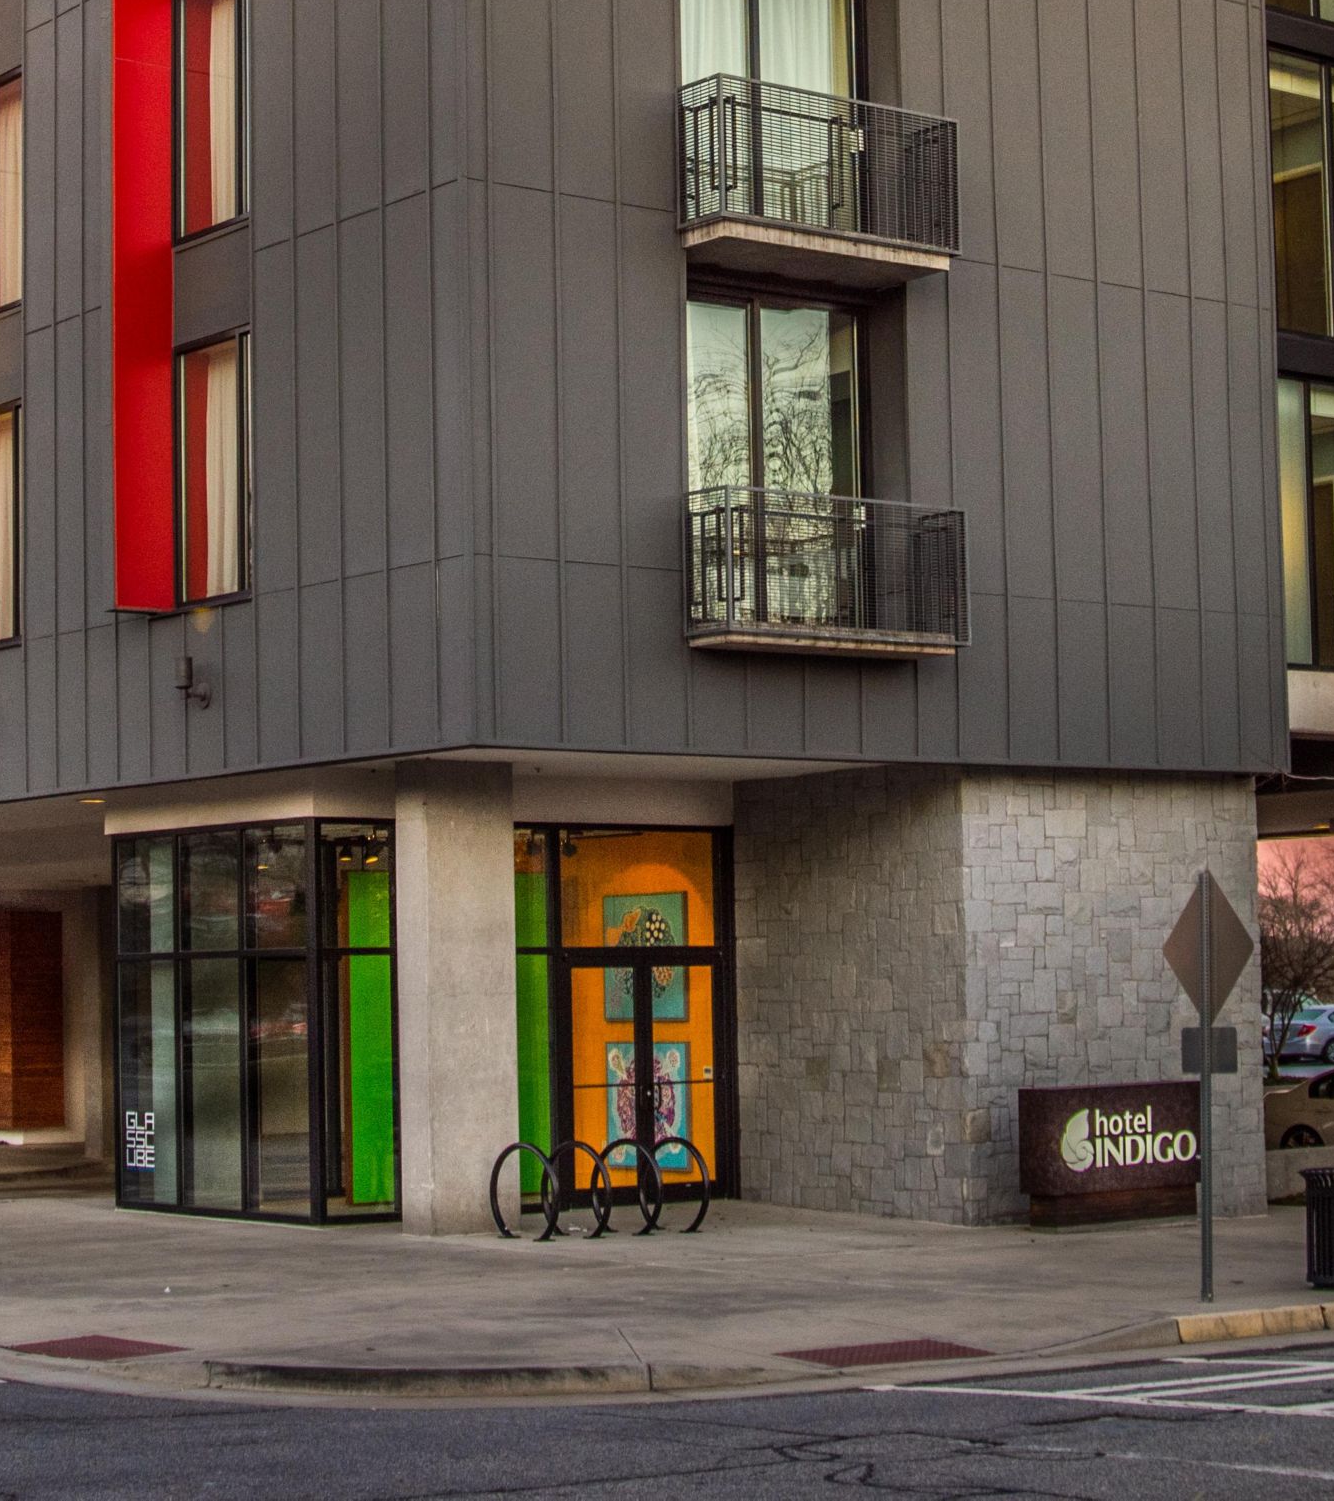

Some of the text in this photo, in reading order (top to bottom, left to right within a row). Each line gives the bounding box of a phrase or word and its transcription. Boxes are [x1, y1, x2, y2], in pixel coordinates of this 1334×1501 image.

[126, 1111, 155, 1130] GLA
[1095, 1105, 1153, 1136] hotel
[126, 1130, 155, 1149] SSC
[1095, 1130, 1197, 1168] INDIGO
[126, 1148, 155, 1168] UBE
